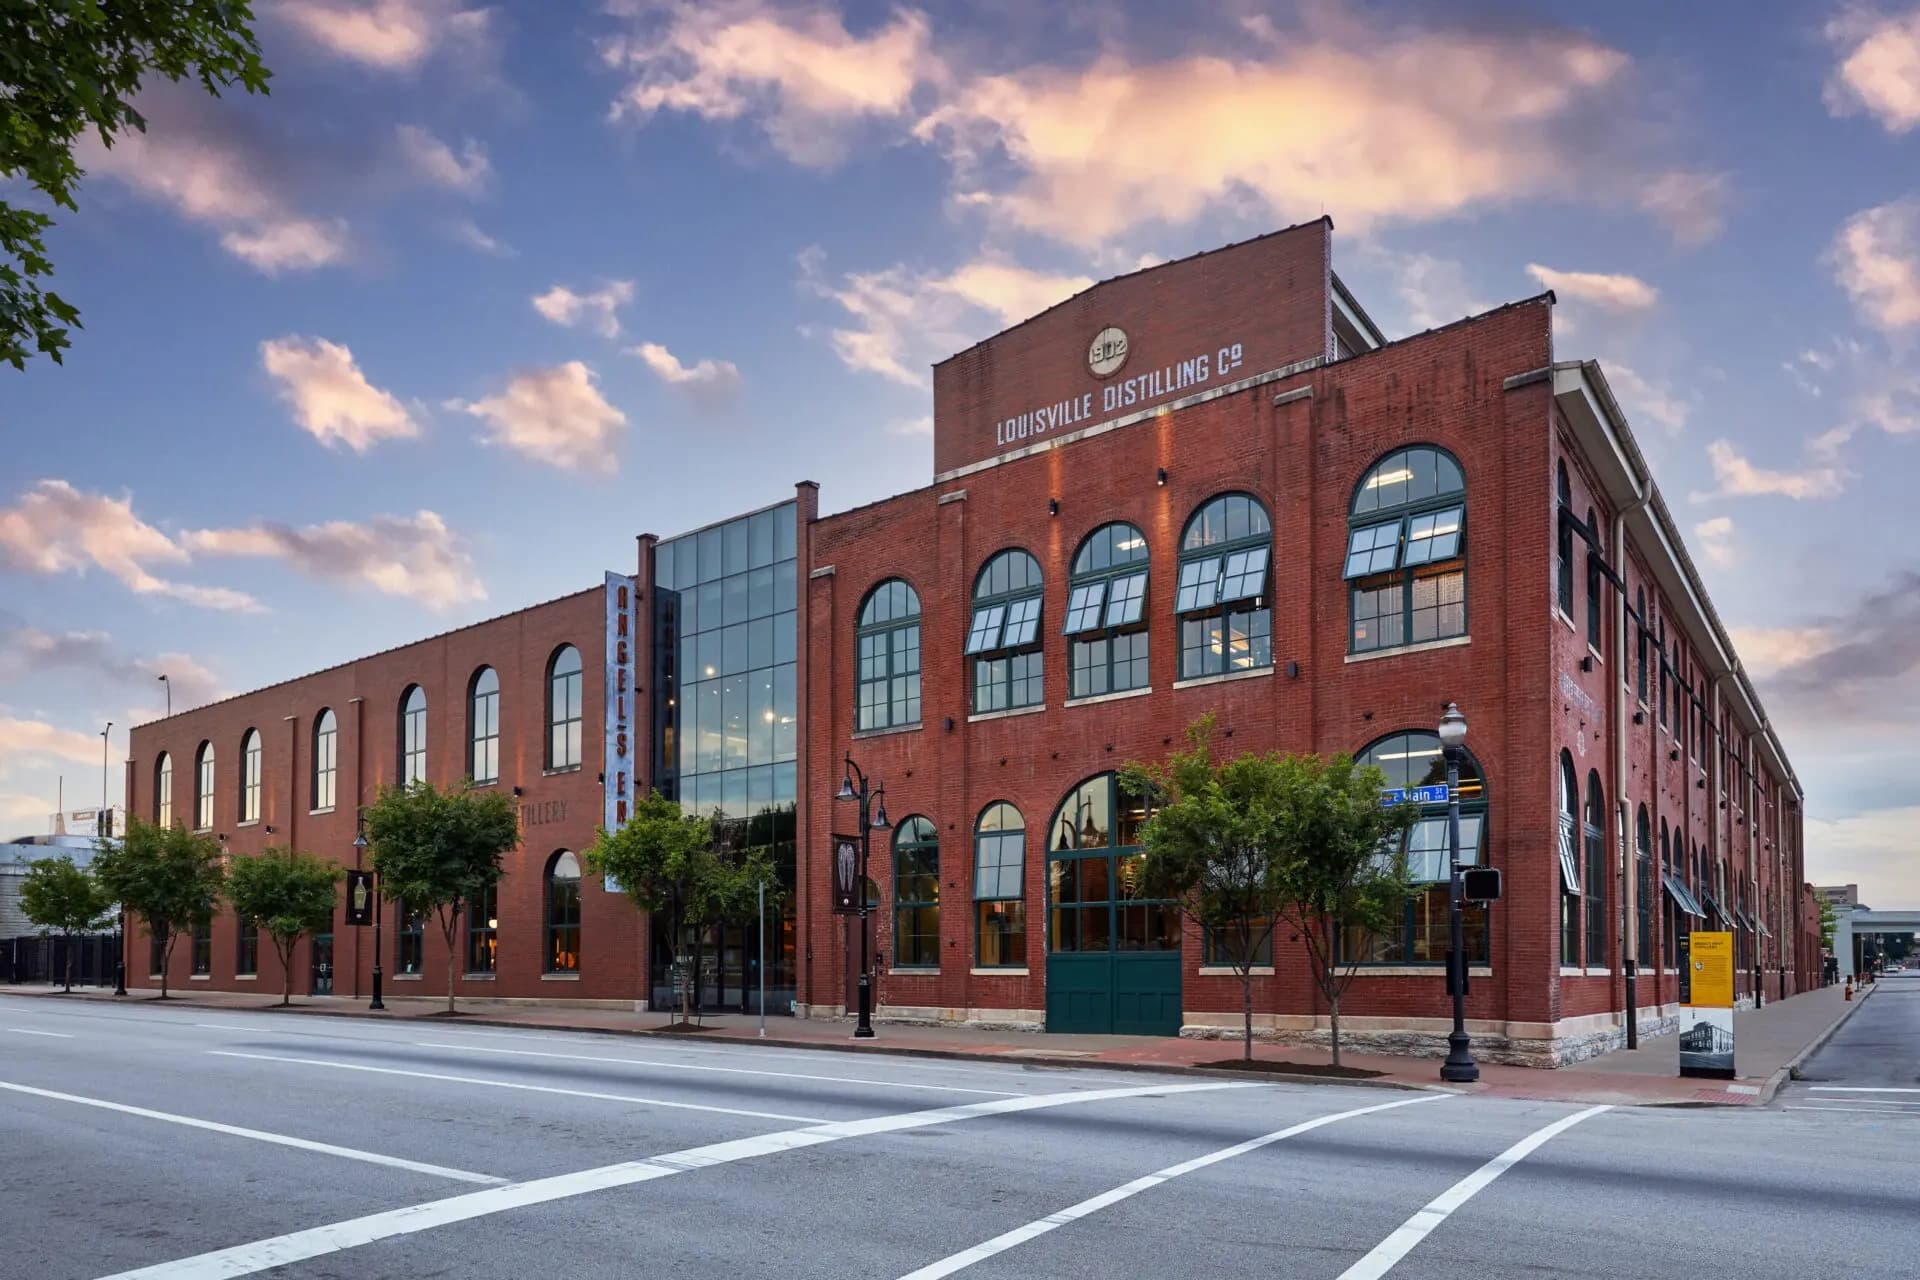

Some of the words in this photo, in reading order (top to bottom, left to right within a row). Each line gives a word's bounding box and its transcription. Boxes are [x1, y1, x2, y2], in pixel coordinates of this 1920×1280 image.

[1089, 340, 1126, 365] 1902
[997, 393, 1093, 445] LOUISVILLE
[1103, 354, 1209, 412] DISTILLING
